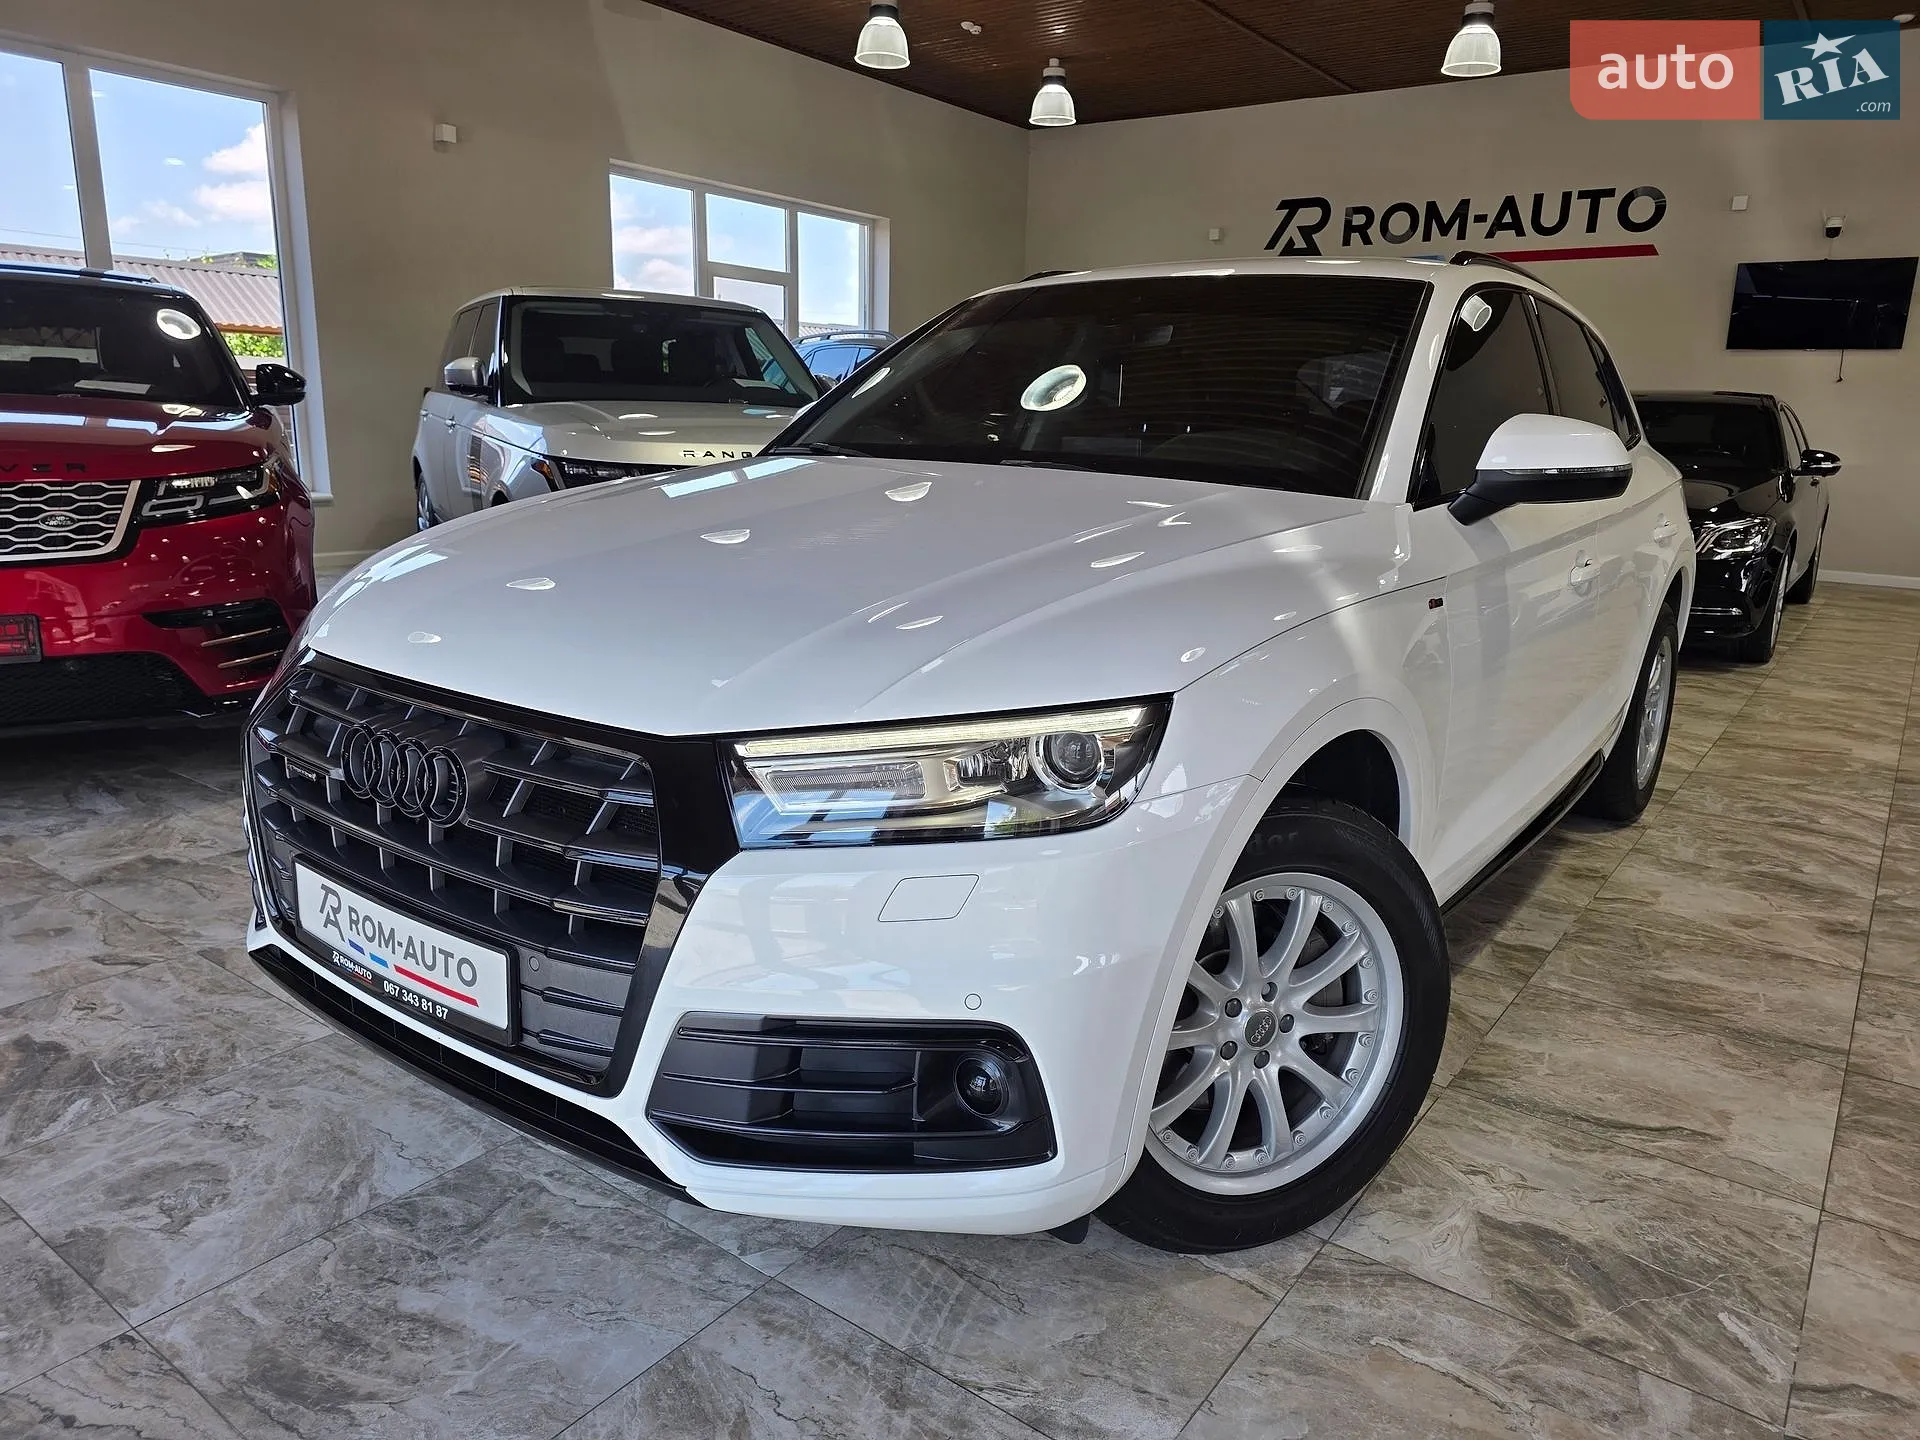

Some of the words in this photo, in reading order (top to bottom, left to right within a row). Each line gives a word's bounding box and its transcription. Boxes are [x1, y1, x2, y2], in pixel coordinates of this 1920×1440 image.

[1341, 185, 1667, 247] ROM-AUTO
[682, 449, 753, 459] RANG
[347, 905, 478, 988] ROM-AUTO
[339, 955, 373, 980] ROM-AUTO
[383, 980, 399, 998] 067
[401, 989, 420, 1008] 343
[421, 999, 434, 1014] 81
[435, 1006, 449, 1020] 87
